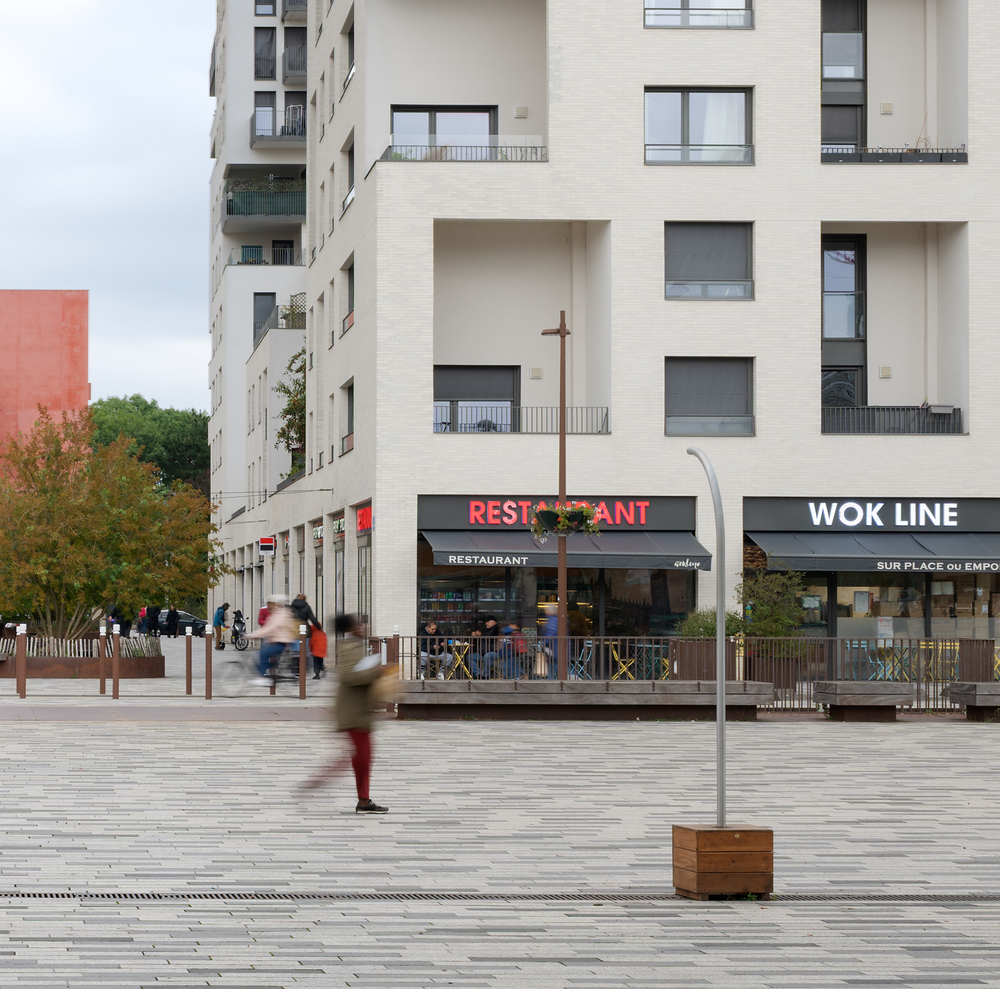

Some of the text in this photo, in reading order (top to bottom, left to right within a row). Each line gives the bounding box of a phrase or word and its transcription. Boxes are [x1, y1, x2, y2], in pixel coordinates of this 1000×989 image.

[469, 500, 650, 526] RESTANT
[808, 502, 958, 527] WOK LINE
[448, 555, 529, 565] RESTAURANT
[876, 561, 902, 570] SUR
[904, 562, 944, 571] PLACE
[964, 562, 1000, 571] EMPO
